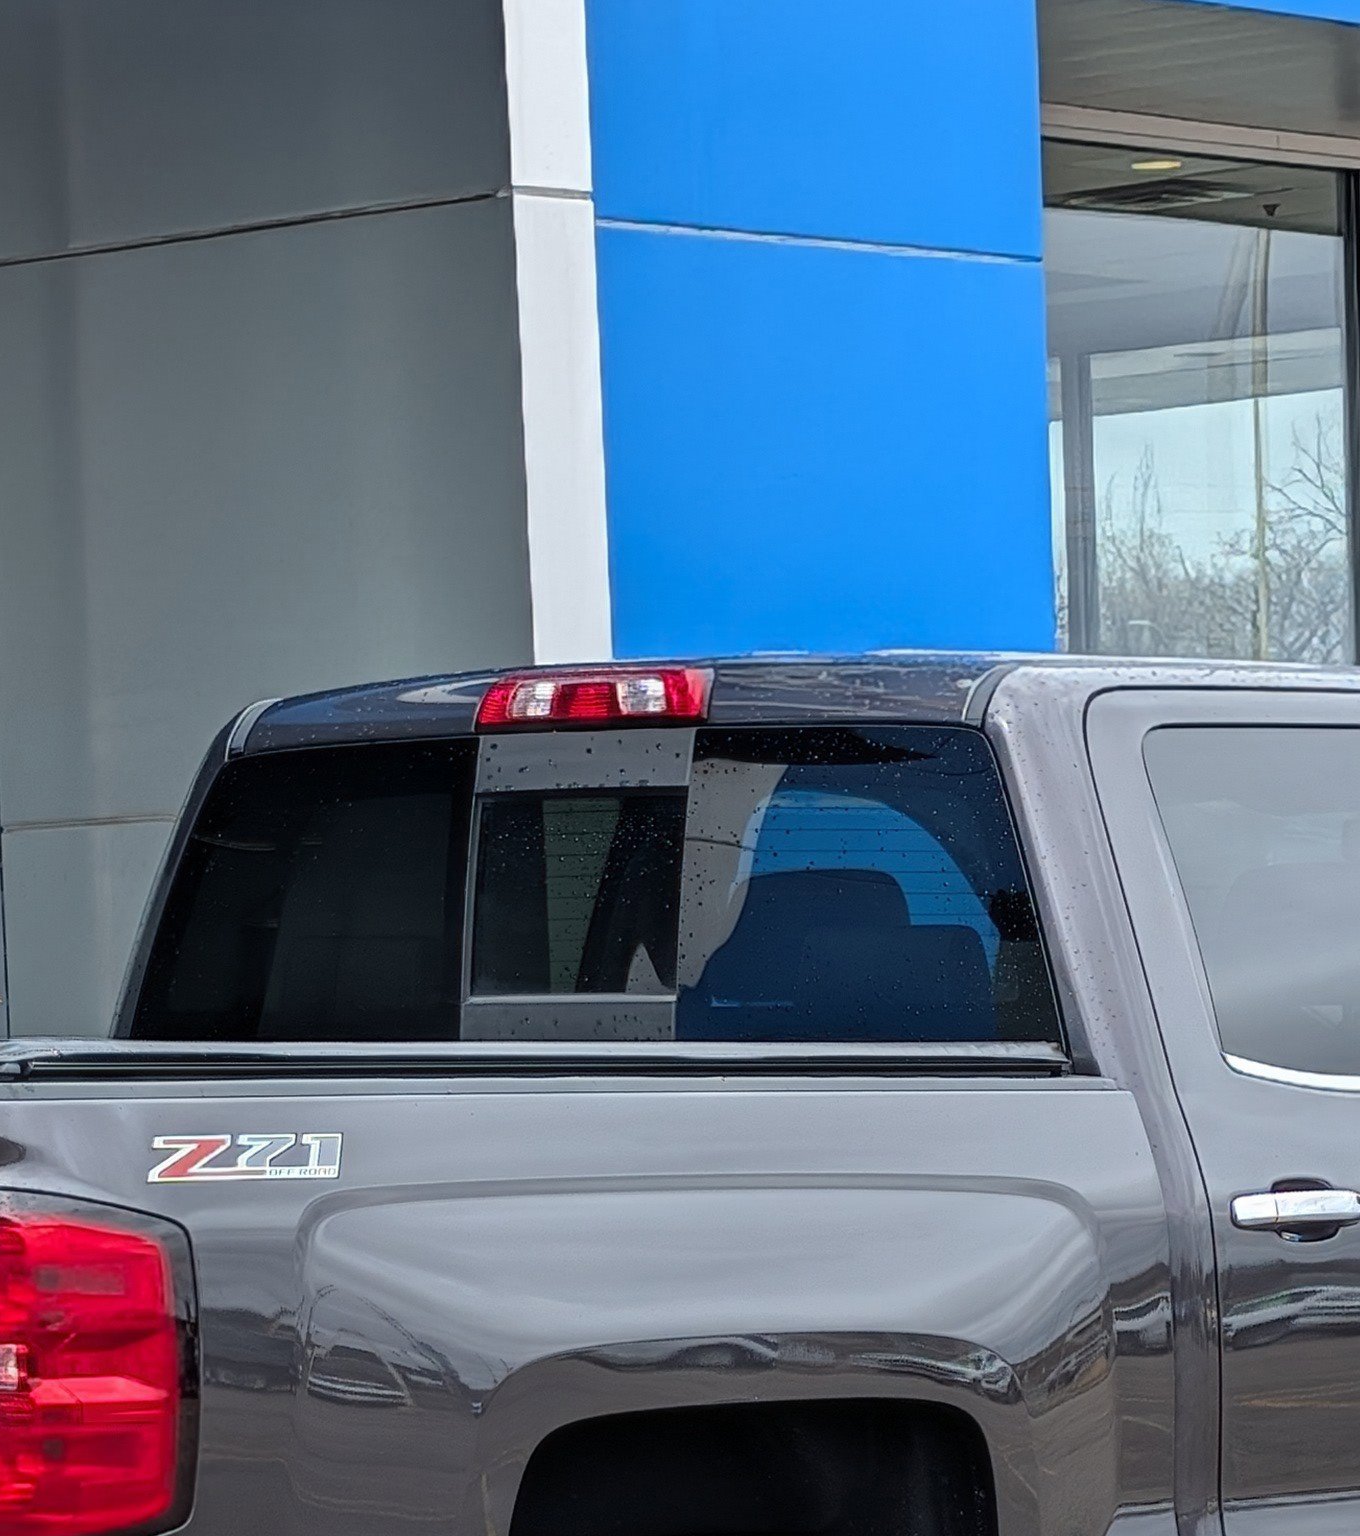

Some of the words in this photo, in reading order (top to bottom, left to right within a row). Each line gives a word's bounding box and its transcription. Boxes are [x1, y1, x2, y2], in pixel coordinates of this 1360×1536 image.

[146, 1132, 344, 1184] Z71
[268, 1168, 296, 1177] OFF
[298, 1167, 338, 1177] ROAD
